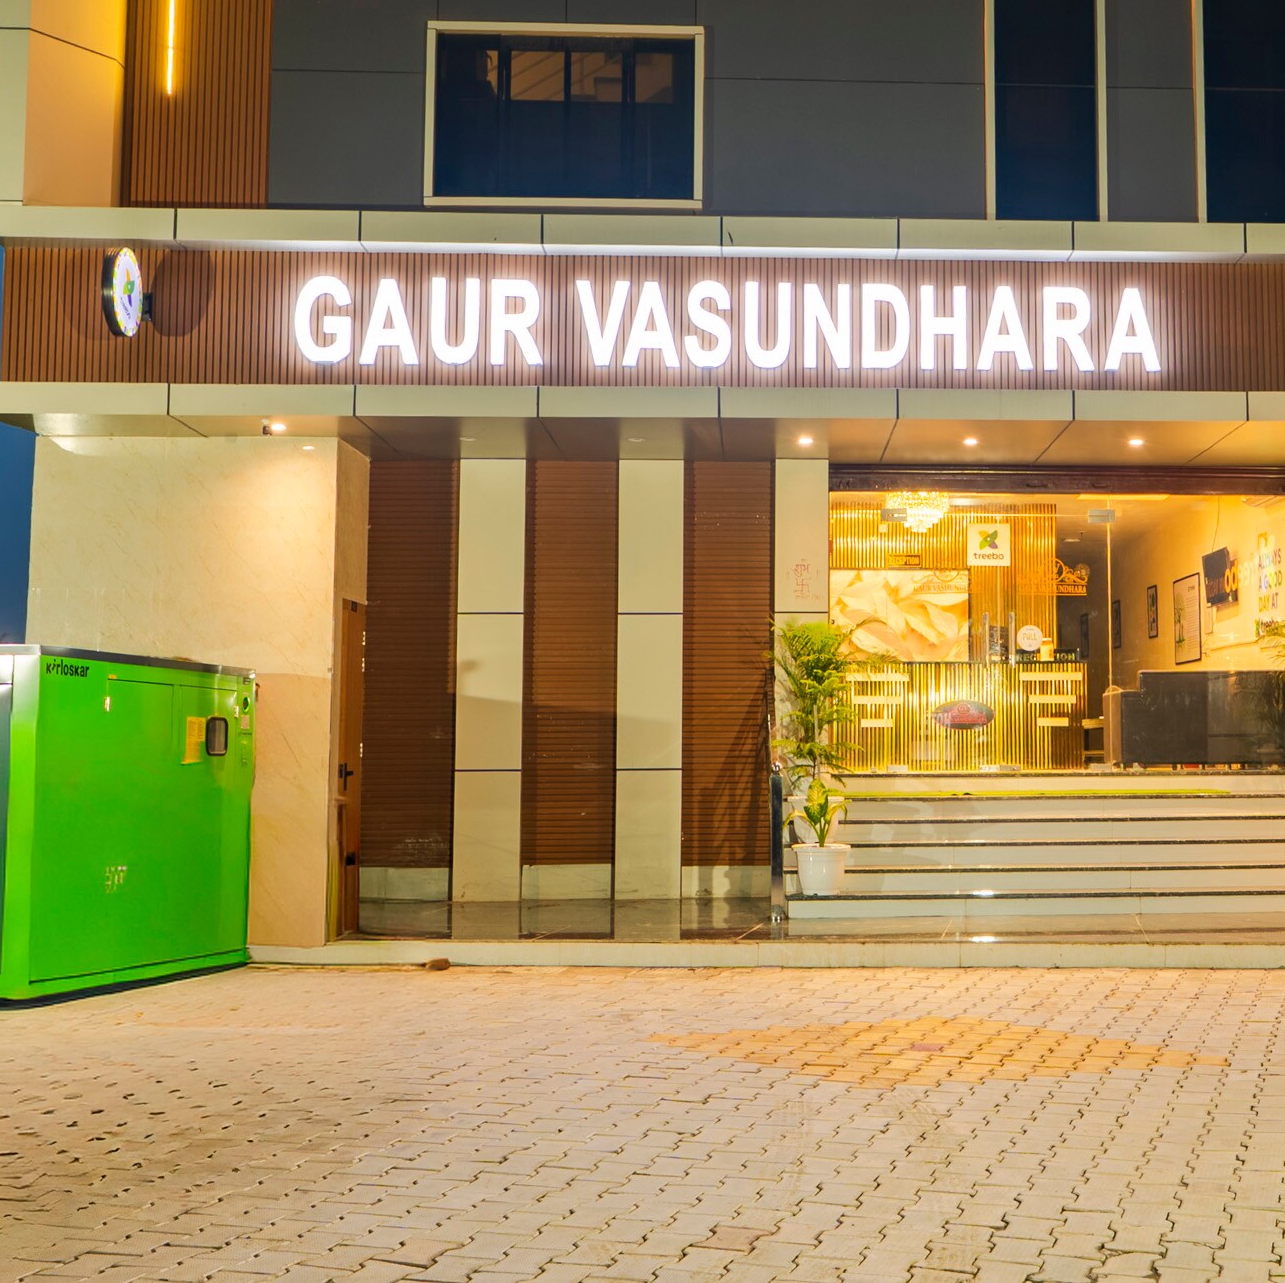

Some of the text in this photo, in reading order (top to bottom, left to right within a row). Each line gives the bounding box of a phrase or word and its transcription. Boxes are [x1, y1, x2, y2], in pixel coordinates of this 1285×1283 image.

[294, 275, 1162, 372] GAUR VASUNDHARA
[973, 552, 1005, 560] treebo
[1263, 570, 1282, 590] GOOD
